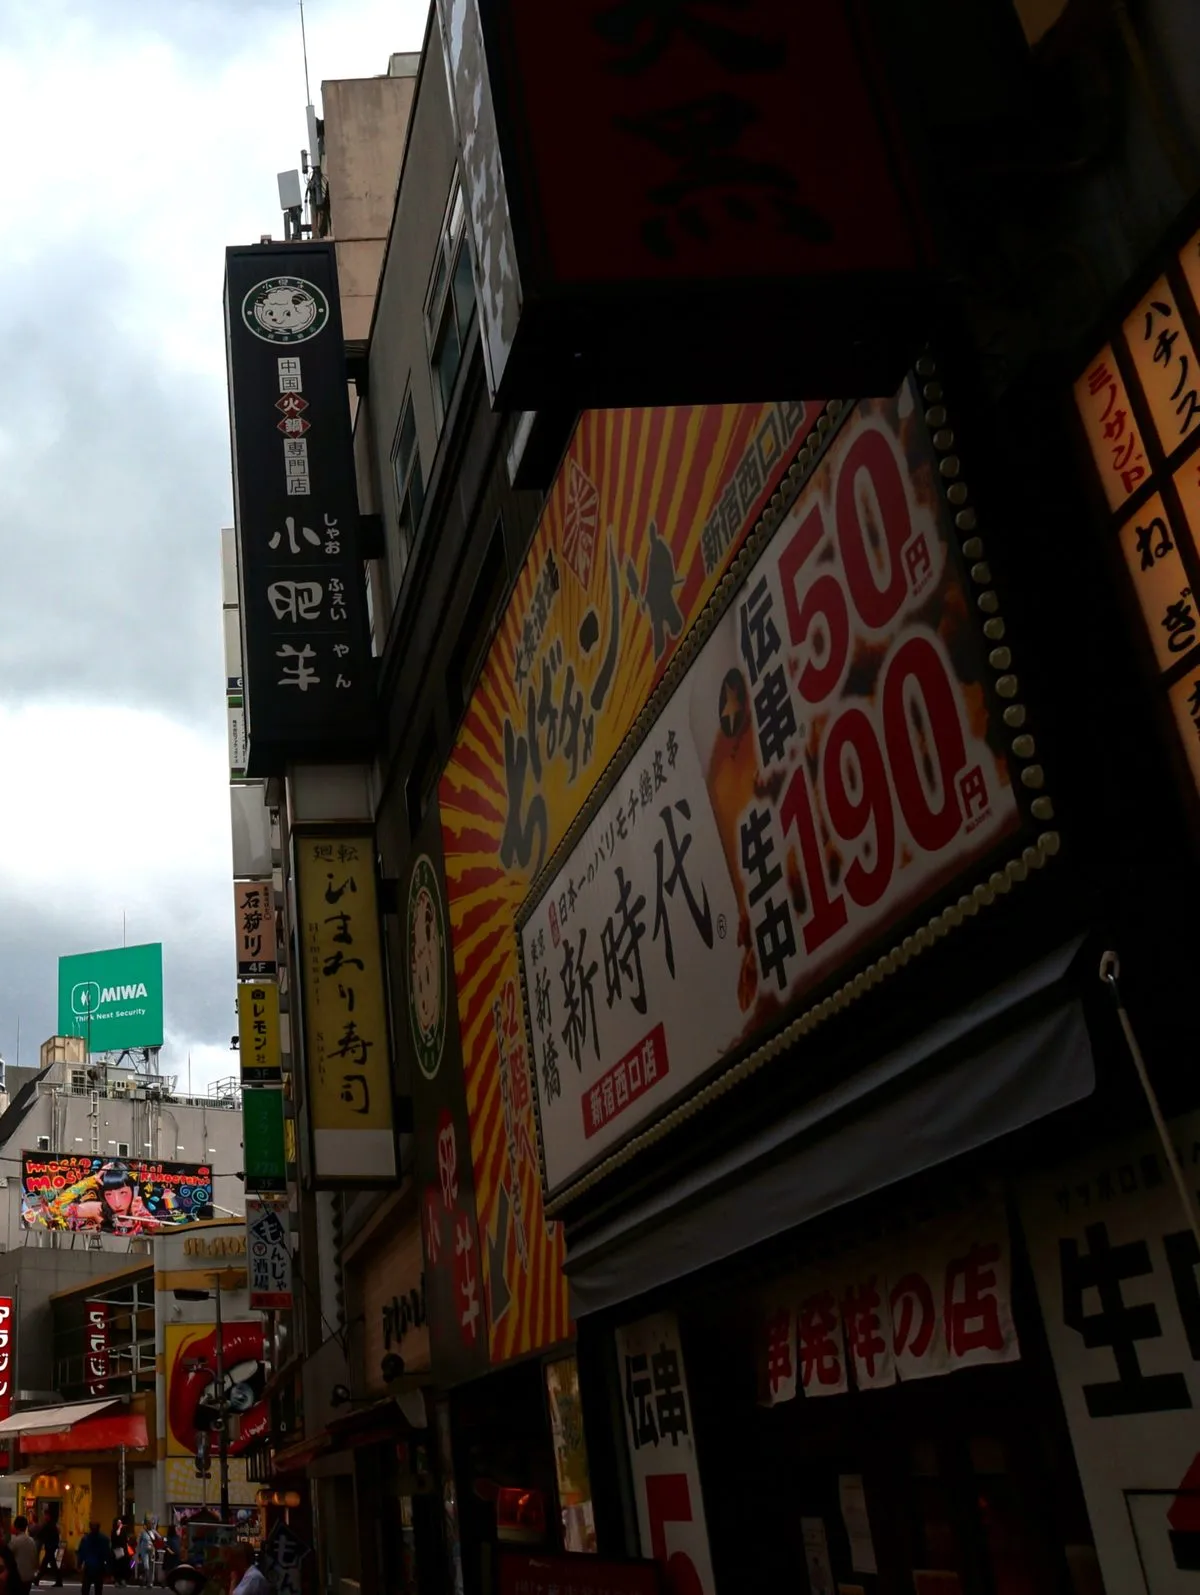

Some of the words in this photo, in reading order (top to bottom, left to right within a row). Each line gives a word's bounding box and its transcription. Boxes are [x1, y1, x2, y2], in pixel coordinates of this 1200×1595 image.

[278, 359, 309, 494] 中国火鍋専門店
[267, 515, 324, 692] 小肥羊
[1135, 517, 1196, 653] ねぎ
[739, 573, 798, 771] 伝串
[240, 890, 263, 958] 石狩川
[560, 797, 714, 1076] 新時代
[739, 807, 799, 993] 生中
[96, 1012, 114, 1021] Next
[115, 1007, 146, 1018] Security
[101, 983, 148, 1003] MIWA
[249, 962, 267, 974] 4F
[323, 873, 374, 1115] ひまわり寿司
[252, 1068, 271, 1080] 3F
[589, 1036, 660, 1131] 新宿西口店
[624, 1341, 689, 1450] 伝串
